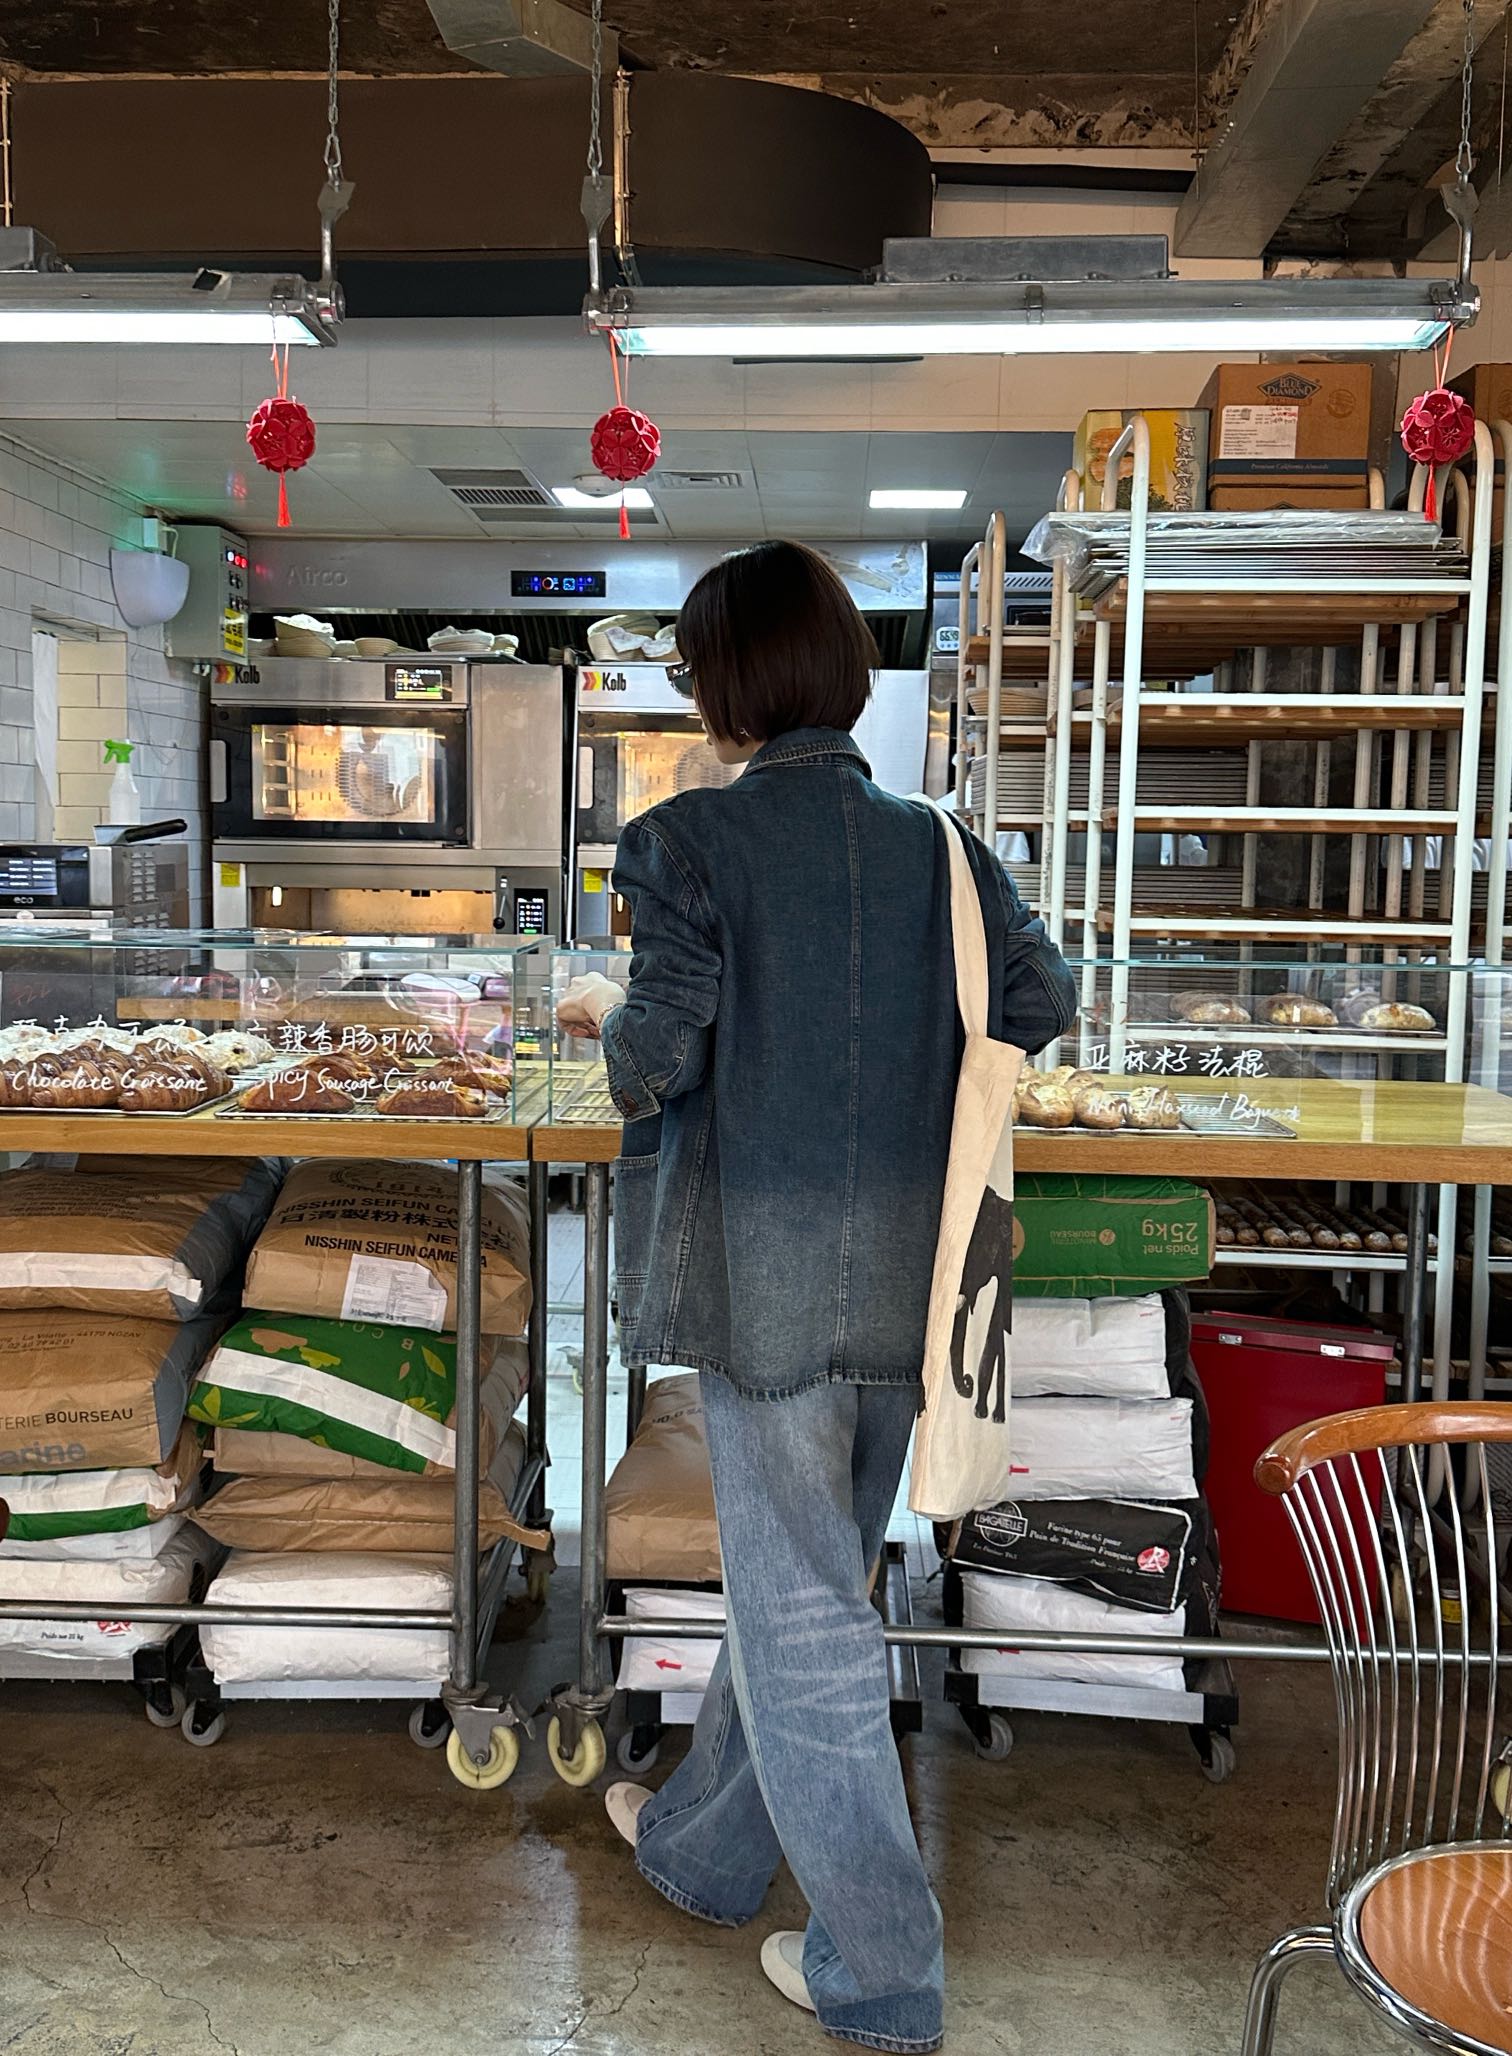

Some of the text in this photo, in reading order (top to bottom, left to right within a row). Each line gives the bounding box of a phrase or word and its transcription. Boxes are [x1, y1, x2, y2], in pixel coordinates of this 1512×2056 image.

[1267, 385, 1313, 397] DIAMOND
[1279, 377, 1301, 388] BLUE
[287, 563, 348, 586] Airco
[235, 665, 260, 684] Kolb
[601, 672, 627, 691] Kolb
[1084, 1038, 1270, 1079] 亚麻籽法棍
[12, 1063, 209, 1093] Chocolate Croissant
[315, 1067, 383, 1101] Sausage
[277, 1198, 357, 1218] NISSHIN
[361, 1197, 430, 1211] SEIFUN
[305, 1234, 362, 1252] NISSHIN
[365, 1240, 417, 1258] SEIFUN
[418, 1246, 488, 1268] CAMEA
[1143, 1244, 1199, 1256] Poids net
[45, 1407, 134, 1424] BOURSEAU
[978, 1513, 1024, 1532] BAGATELLE
[1049, 1534, 1060, 1543] de
